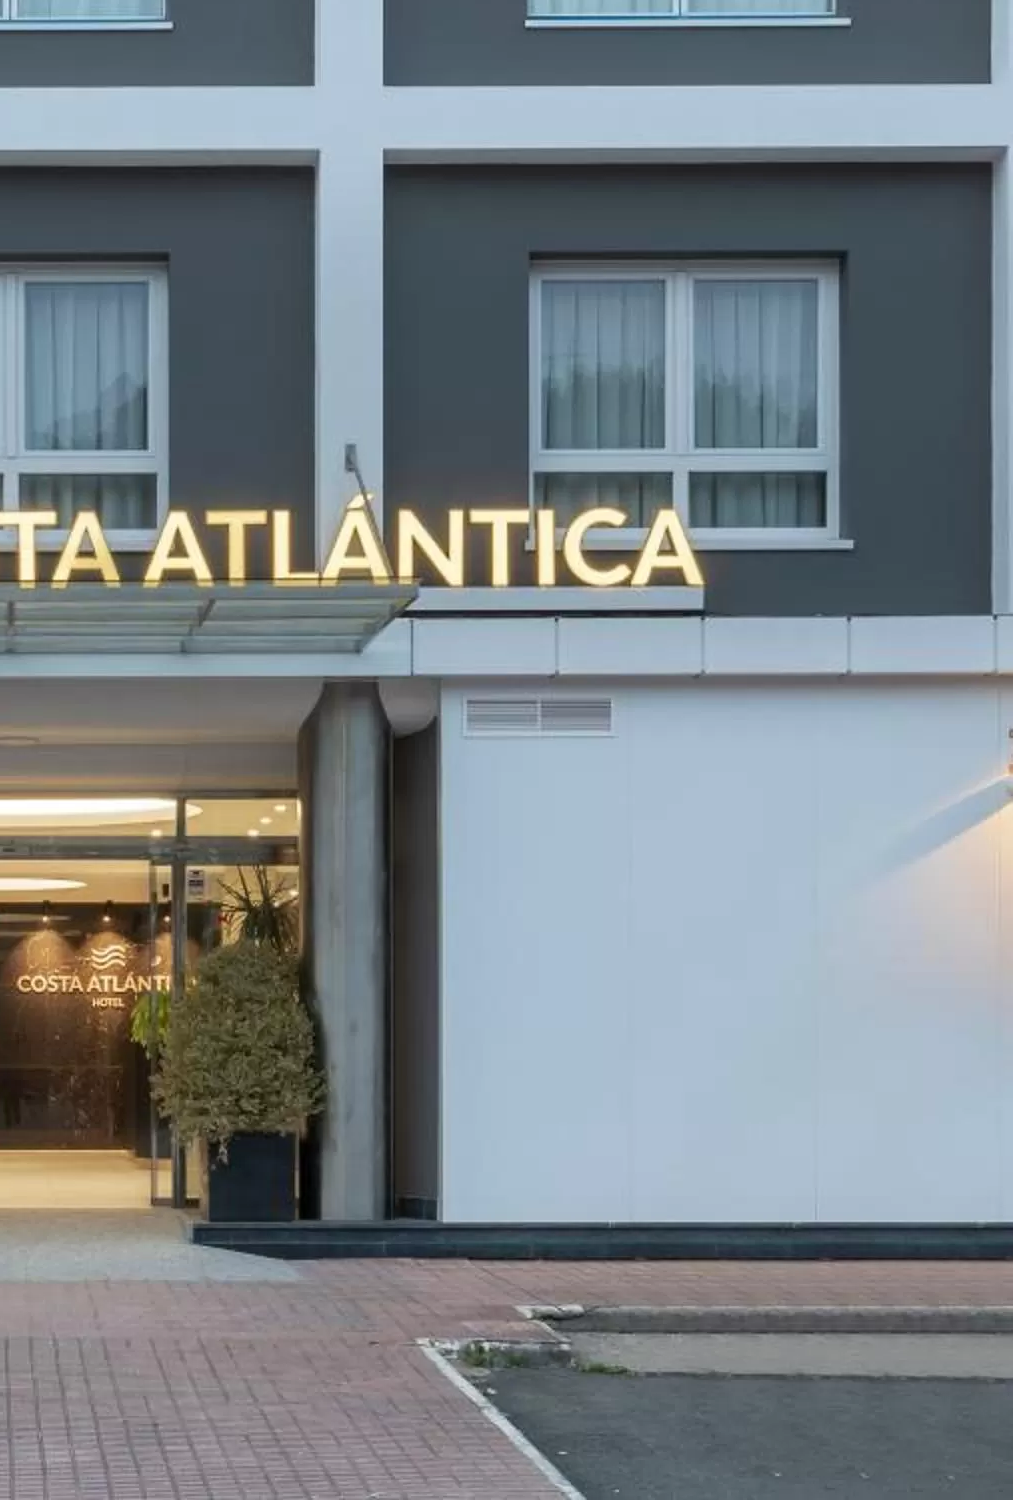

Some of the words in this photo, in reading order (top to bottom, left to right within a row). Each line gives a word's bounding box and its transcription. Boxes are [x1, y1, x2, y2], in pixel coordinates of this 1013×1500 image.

[144, 492, 705, 588] ATLÁNTICA
[17, 975, 83, 993] COSTA
[87, 971, 171, 993] ATLÁNTI
[92, 997, 125, 1008] HOTEL
